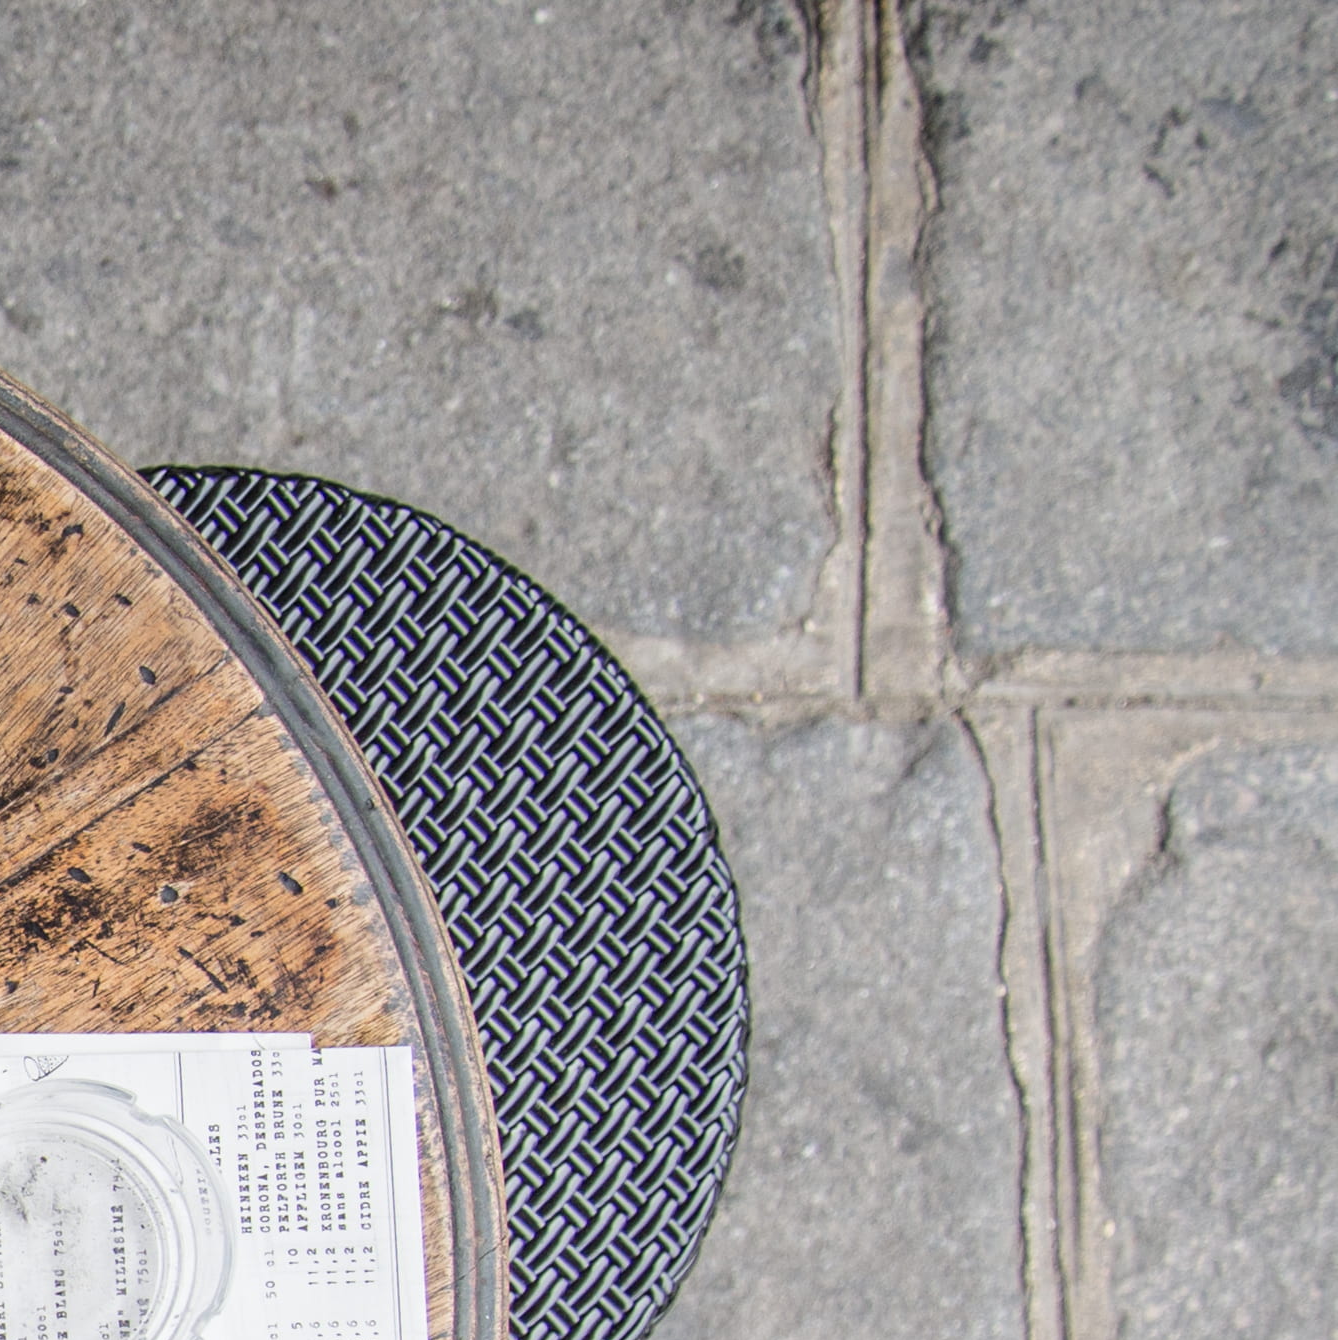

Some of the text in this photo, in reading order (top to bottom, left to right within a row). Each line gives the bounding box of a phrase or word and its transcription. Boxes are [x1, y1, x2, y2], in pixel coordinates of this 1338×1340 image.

[313, 1077, 327, 1107] PUR
[250, 1050, 271, 1233] CORONA, DESPERADOS
[271, 1050, 290, 1233] PELFORTH BRUNE 33c
[329, 1072, 347, 1231] sans alcool 25cl
[353, 1070, 372, 1230] CIDRE APPIE 33cl
[237, 1104, 253, 1234] HEINEKEN 33cl
[315, 1119, 333, 1232] KRONENBOURG
[288, 1248, 299, 1266] 10
[307, 1247, 320, 1286] 11,2
[325, 1246, 339, 1285] 11,2
[344, 1246, 357, 1284] 11,2
[363, 1245, 376, 1284] 11,2
[265, 1280, 277, 1298] 50
